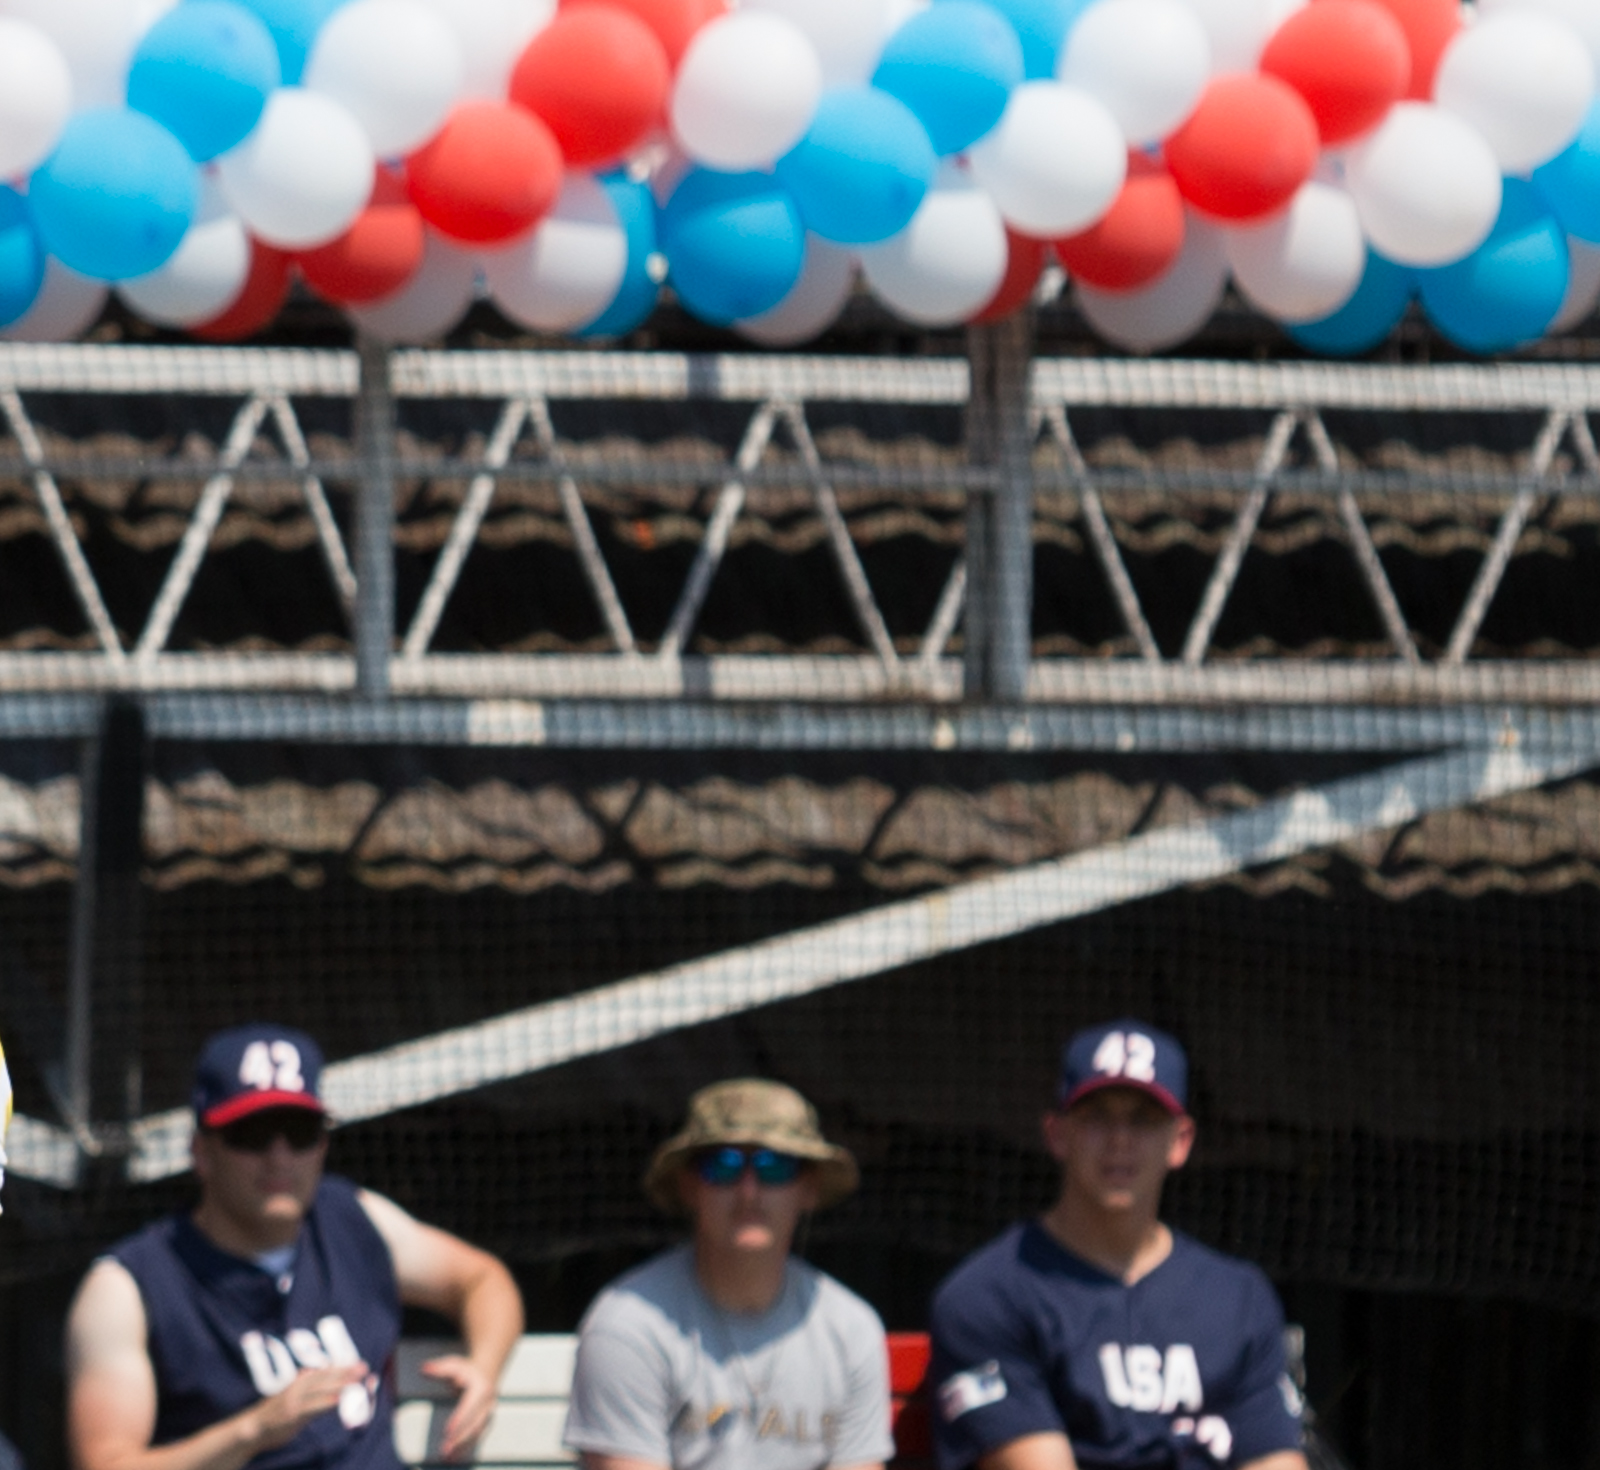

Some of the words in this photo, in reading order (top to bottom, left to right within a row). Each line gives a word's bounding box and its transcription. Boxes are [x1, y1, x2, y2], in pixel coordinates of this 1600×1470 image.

[239, 1040, 305, 1093] 42
[1092, 1031, 1156, 1083] 42
[1099, 1341, 1204, 1414] USA
